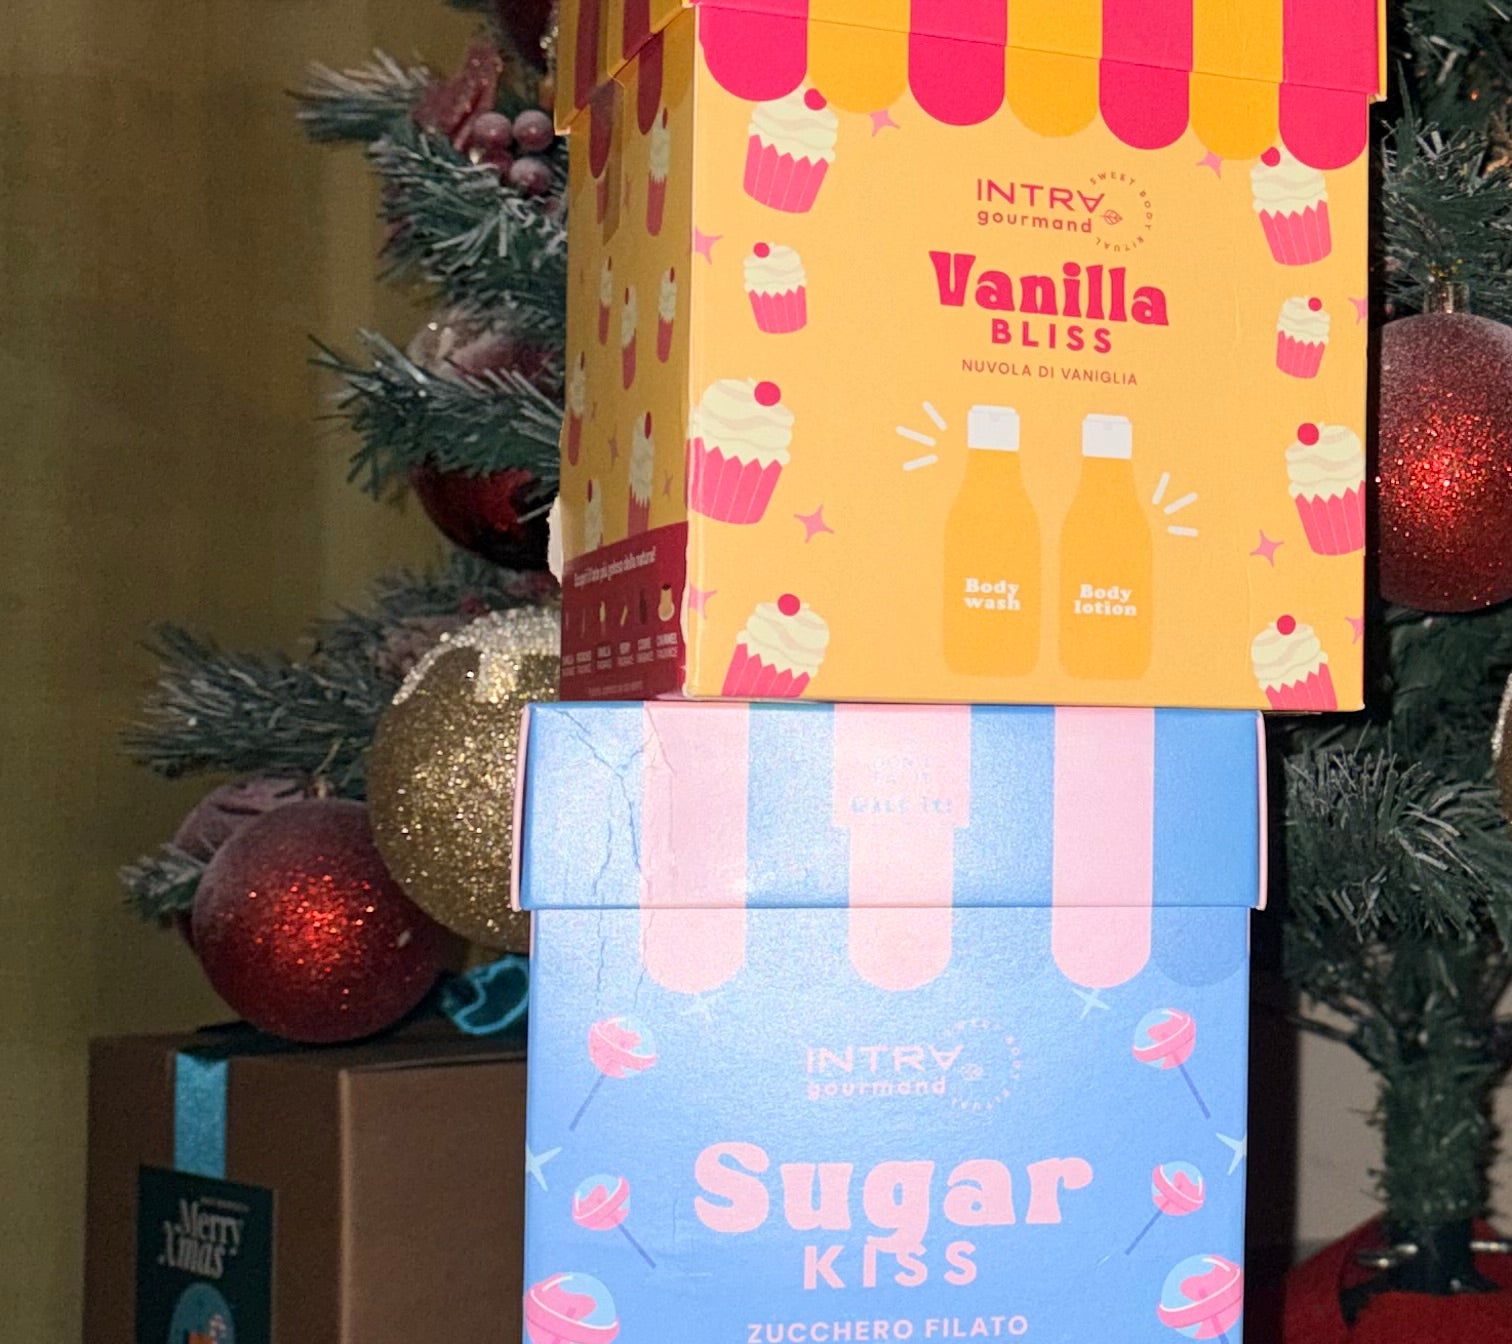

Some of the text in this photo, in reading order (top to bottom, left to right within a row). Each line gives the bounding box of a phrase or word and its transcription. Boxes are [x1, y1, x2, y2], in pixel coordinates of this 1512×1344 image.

[1090, 172, 1135, 186] SWEET
[977, 210, 1092, 233] gourmand
[929, 250, 1169, 326] Vanilla
[992, 318, 1111, 353] BLISS
[962, 360, 1138, 385] NUVOLA DI VANIGLIA
[965, 577, 1019, 597] Body
[1080, 584, 1132, 603] Body
[963, 594, 1021, 611] wash
[1074, 600, 1137, 616] lotion
[807, 1075, 946, 1100] gourmand
[694, 1141, 1093, 1253] Sugar
[178, 1198, 245, 1255] Merry
[803, 1241, 978, 1290] KISS
[747, 1315, 1028, 1344] ZUCCHERO FILATO
